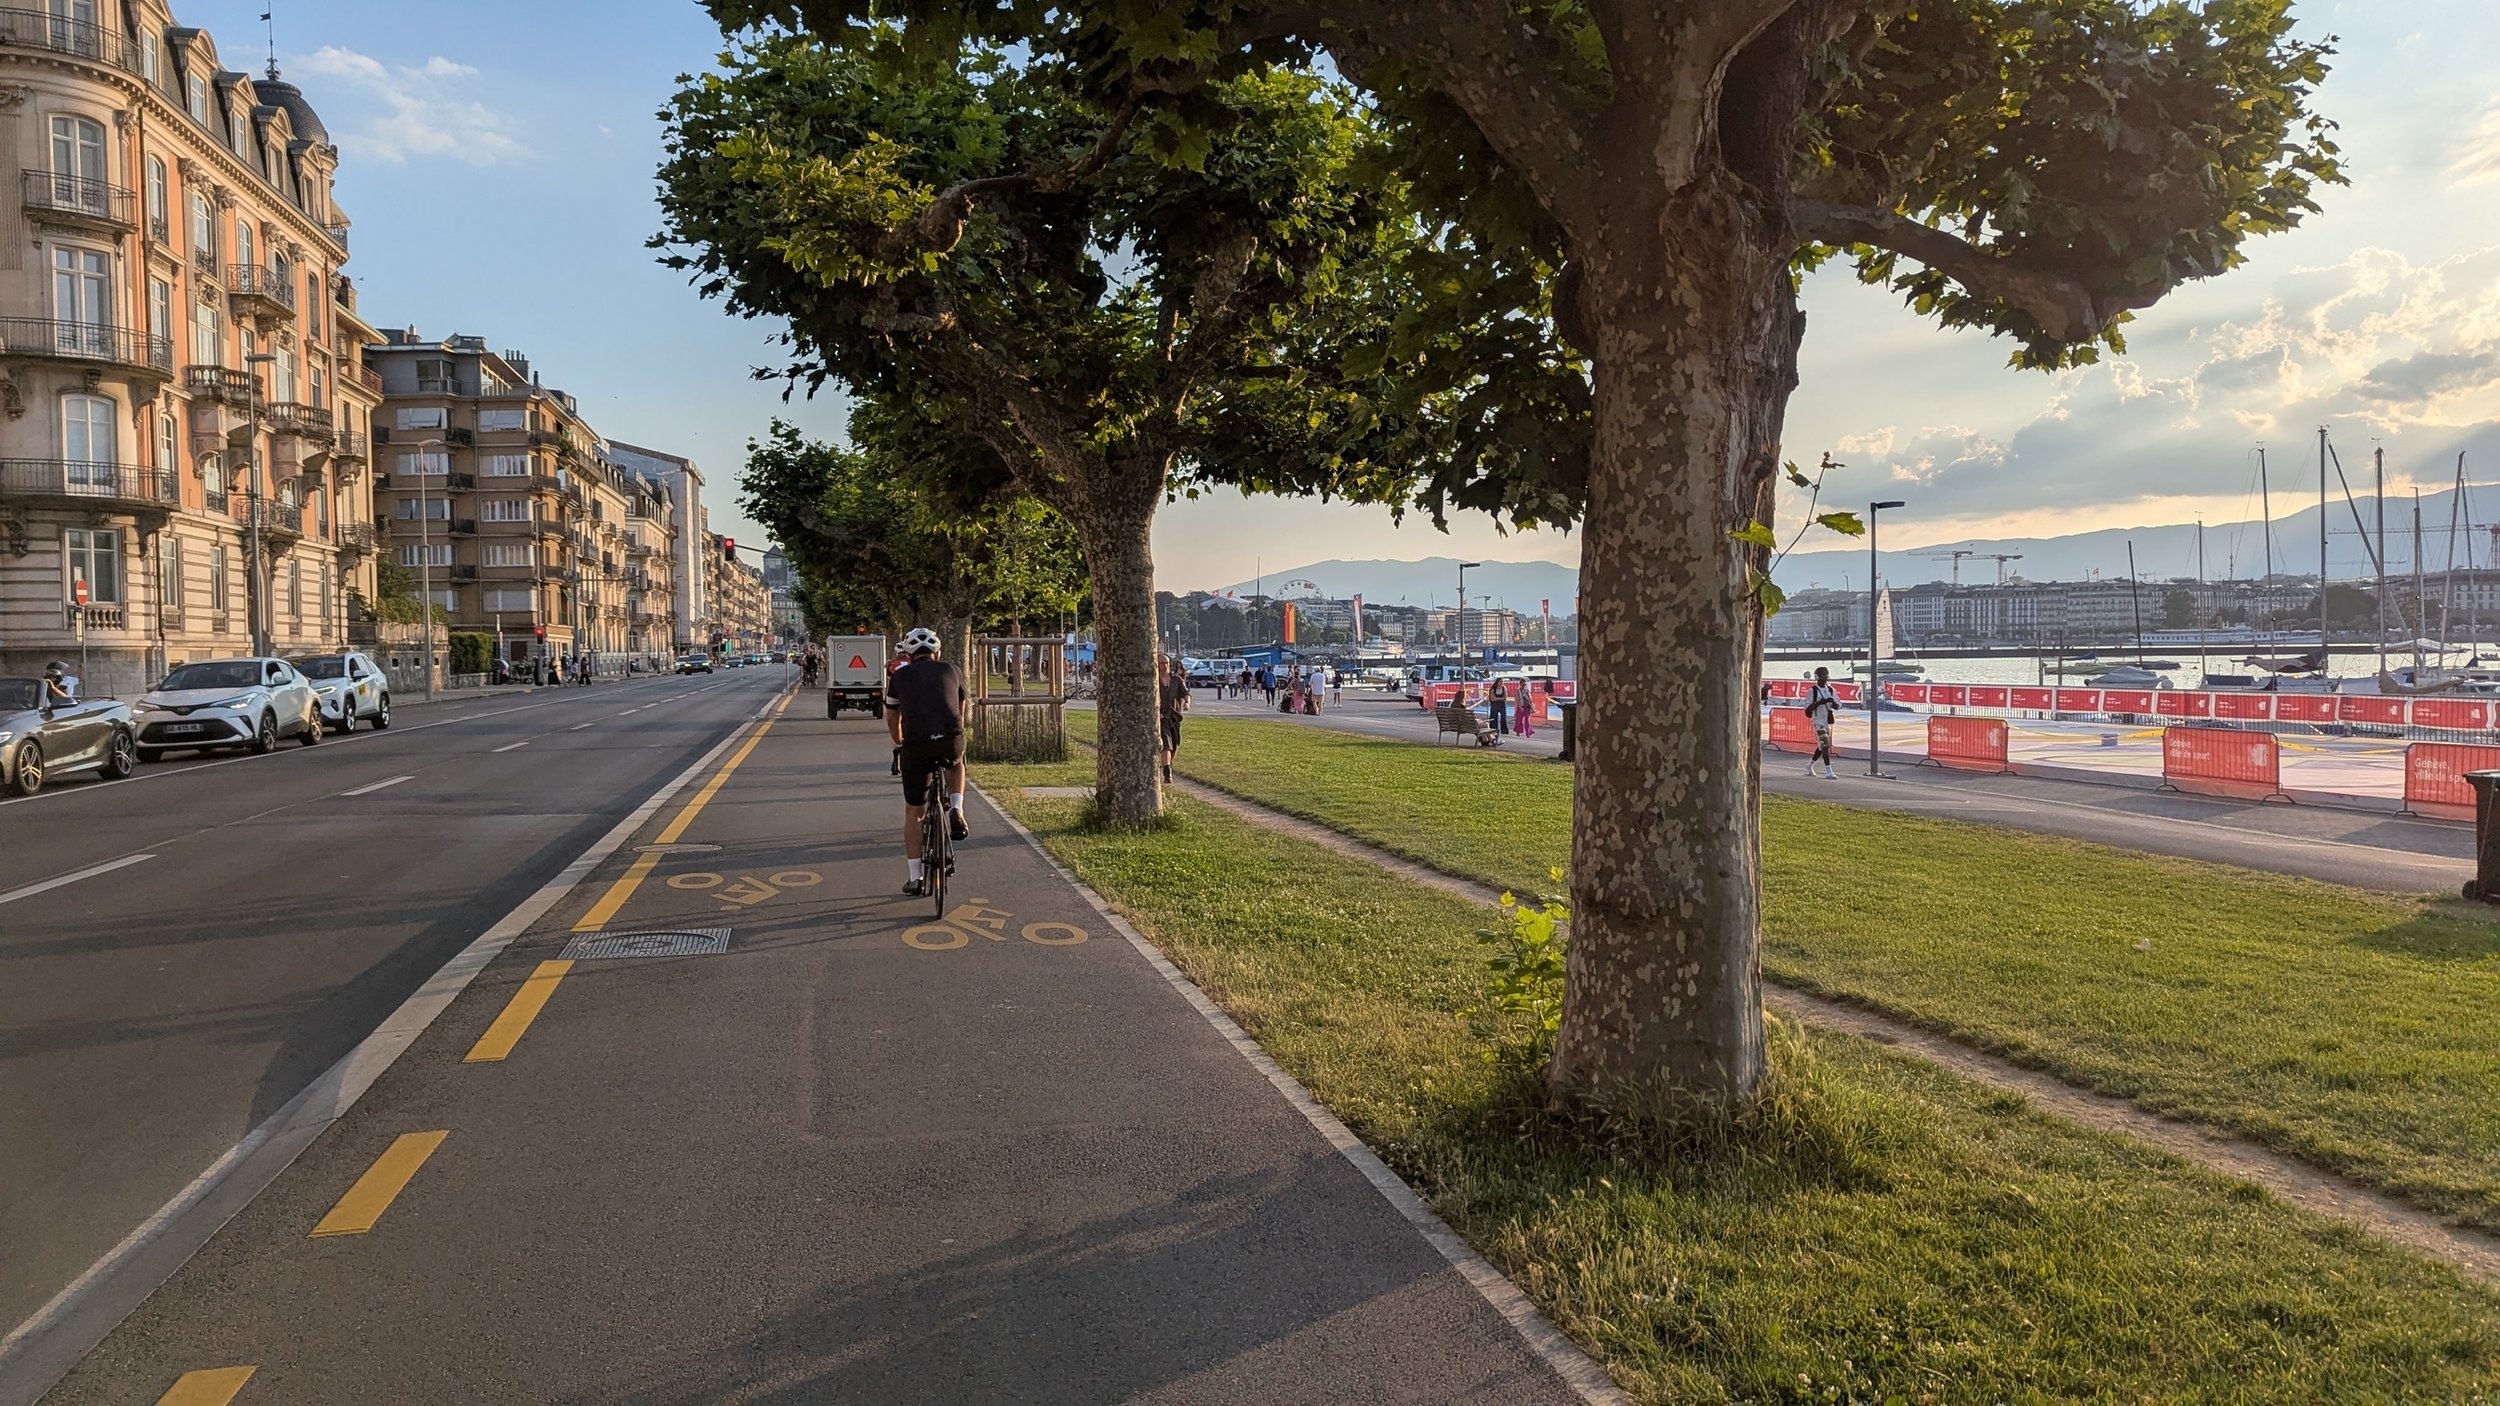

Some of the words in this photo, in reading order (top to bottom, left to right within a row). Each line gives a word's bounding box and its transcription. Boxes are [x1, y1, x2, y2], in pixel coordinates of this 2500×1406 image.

[2193, 751, 2210, 761] sport
[2415, 758, 2449, 771] Genève,
[2415, 769, 2433, 780] ville
[2436, 771, 2446, 782] de
